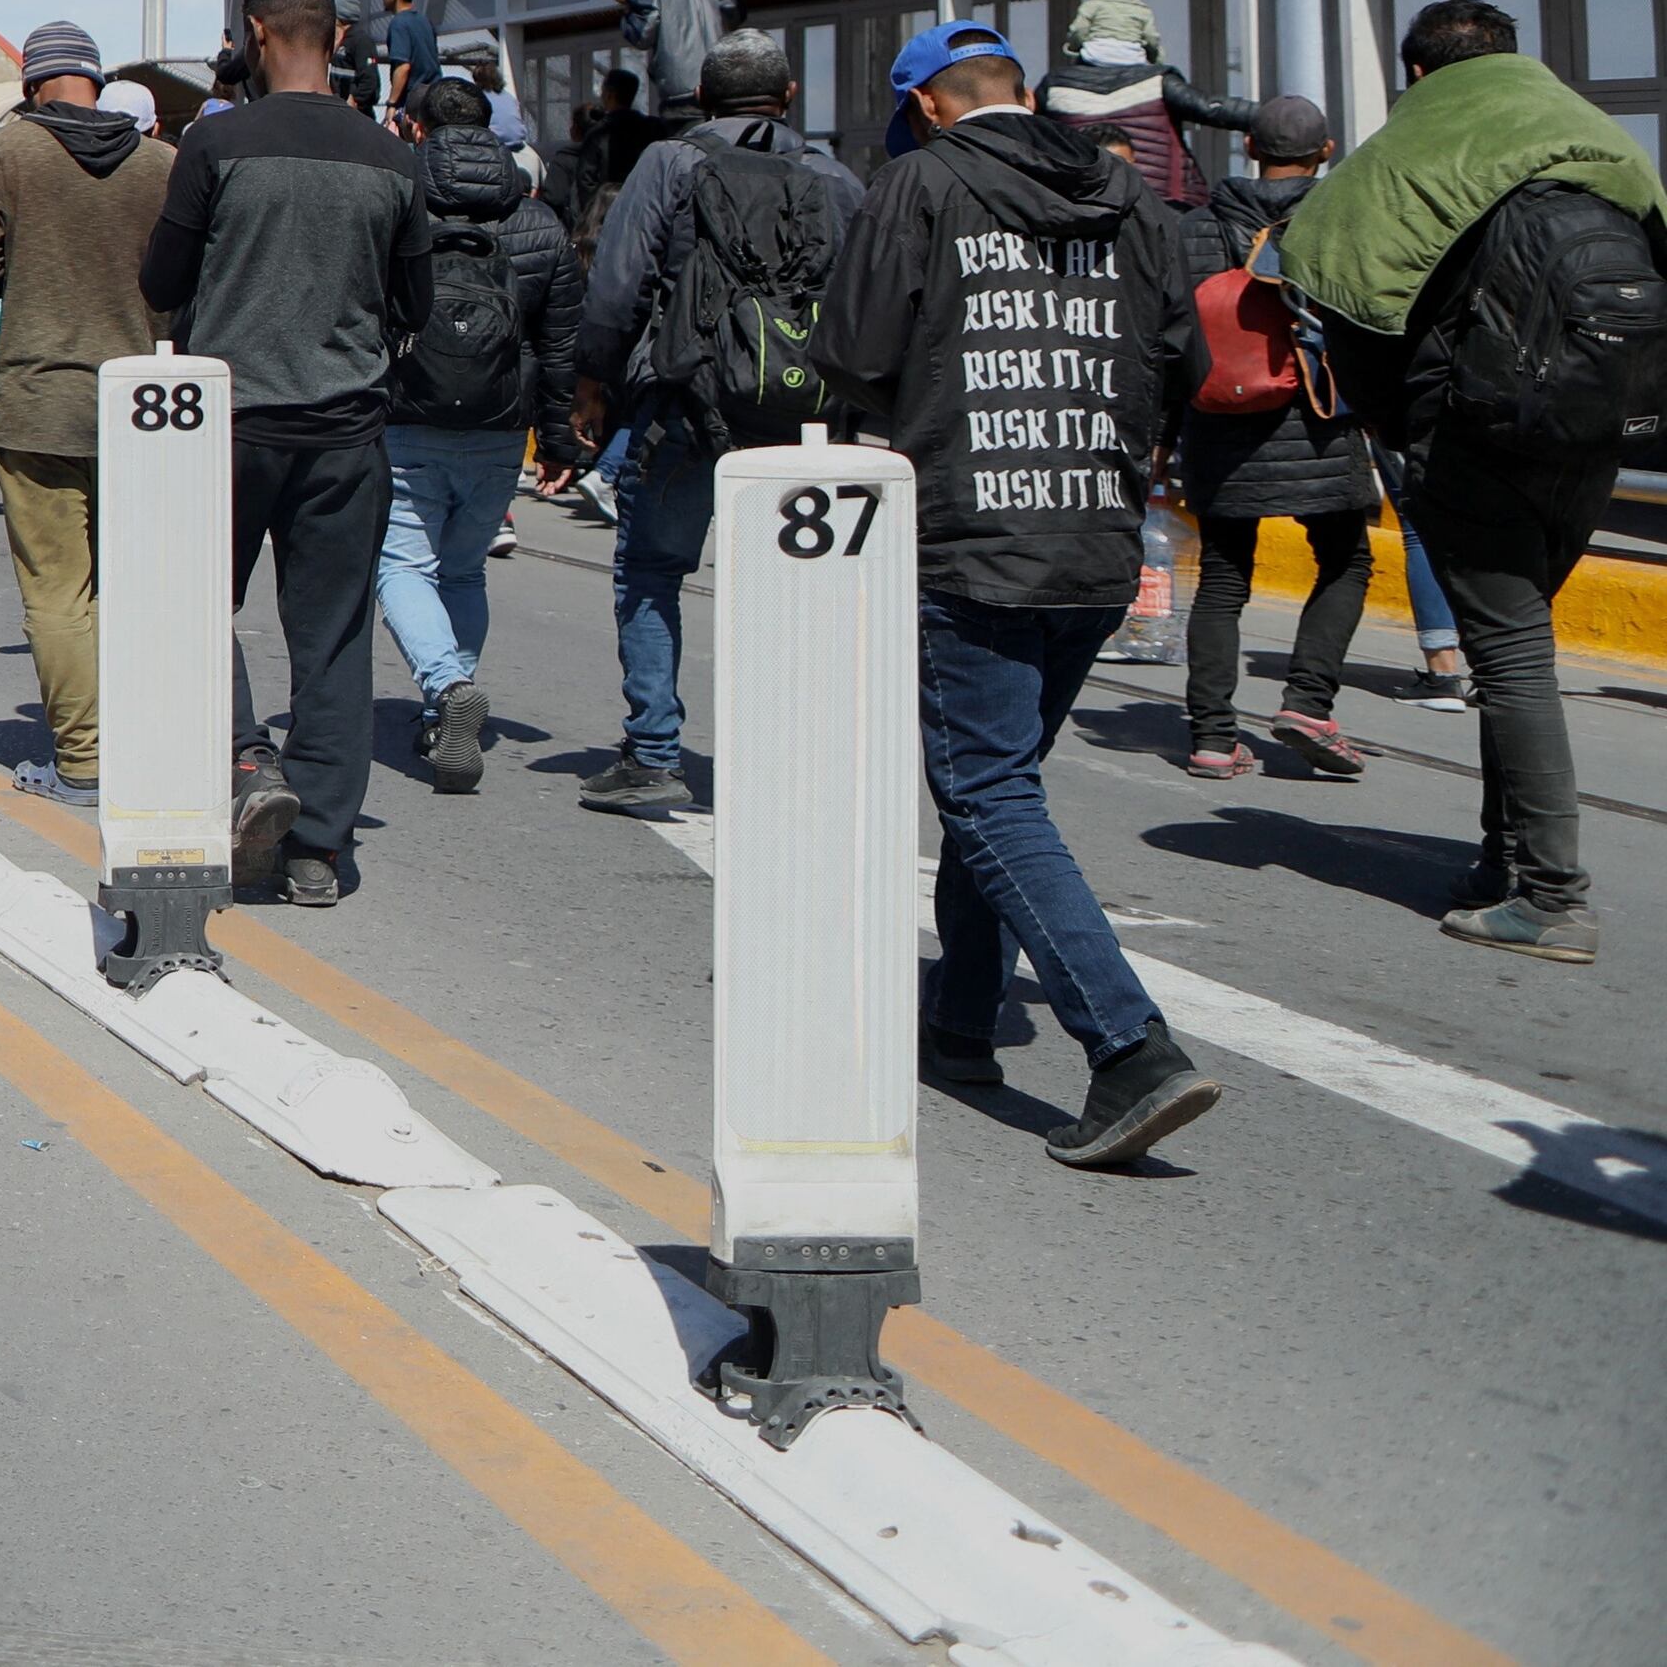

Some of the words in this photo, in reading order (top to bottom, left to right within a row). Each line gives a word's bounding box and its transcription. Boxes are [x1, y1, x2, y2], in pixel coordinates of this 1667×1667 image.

[955, 231, 1031, 278] RISK
[1065, 238, 1120, 279] ALL
[962, 290, 1039, 334] RISK
[1066, 297, 1122, 339] ALL
[962, 349, 1046, 393] RISK
[1050, 349, 1082, 390] IT
[131, 382, 204, 431] 88
[968, 408, 1050, 453] RISK
[1056, 408, 1086, 450] IT
[973, 468, 1056, 512] RISK
[1060, 468, 1092, 510] IT
[1096, 469, 1125, 510] ALL
[778, 483, 883, 559] 87
